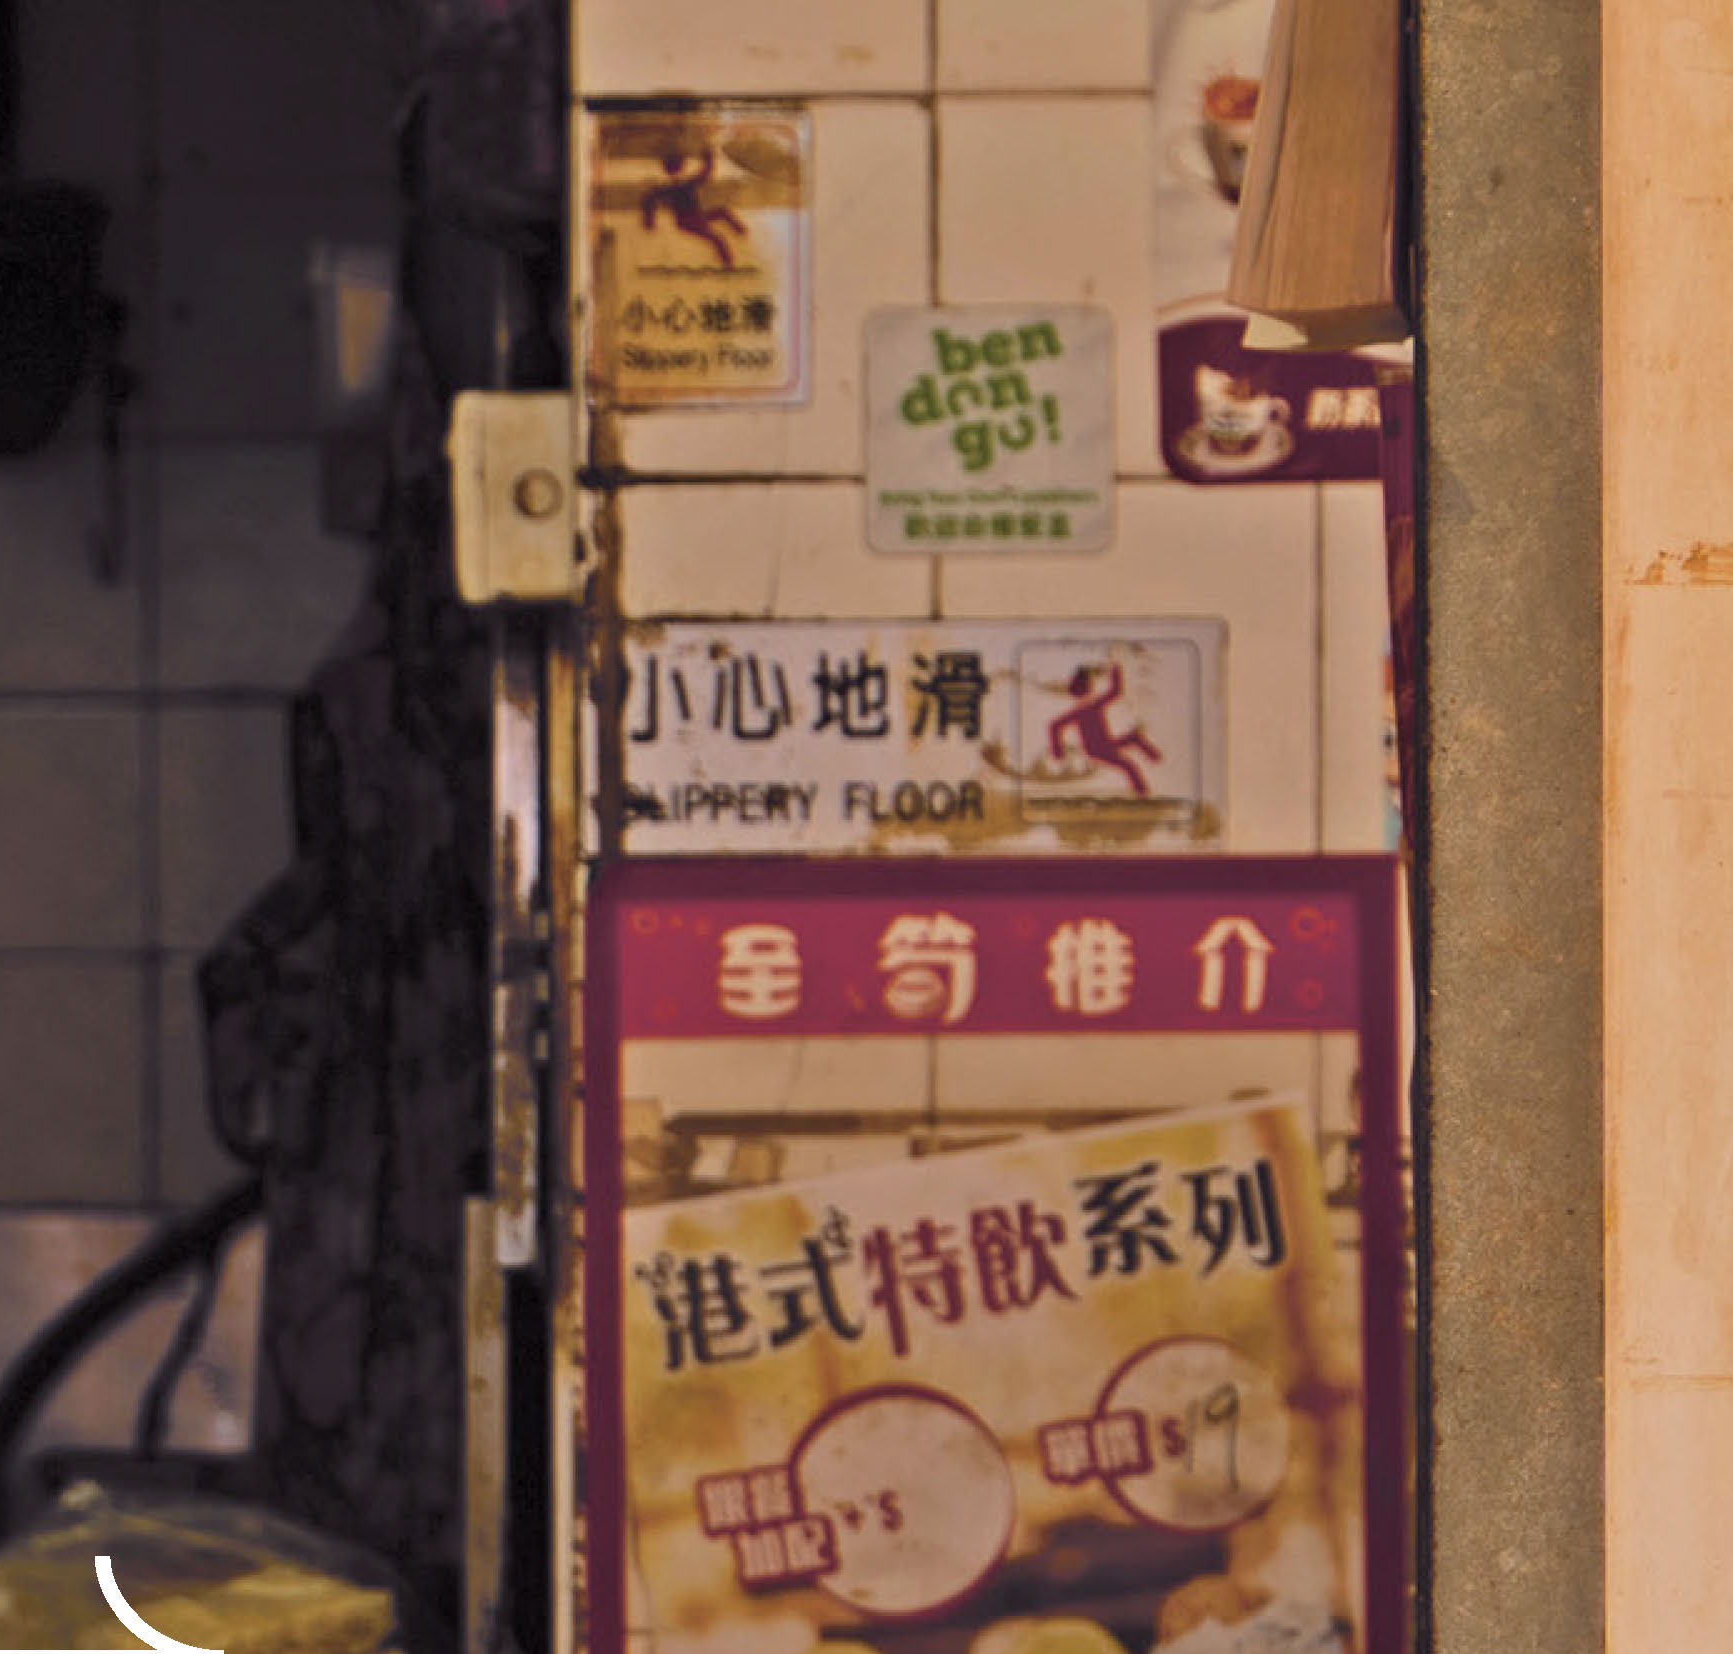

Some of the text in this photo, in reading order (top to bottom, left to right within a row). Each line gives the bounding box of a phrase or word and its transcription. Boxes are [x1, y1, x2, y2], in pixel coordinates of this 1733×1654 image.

[629, 650, 990, 744] 小心地滑
[841, 780, 987, 824] FLOOR
[636, 1158, 1289, 1374] 港式特飲系列
